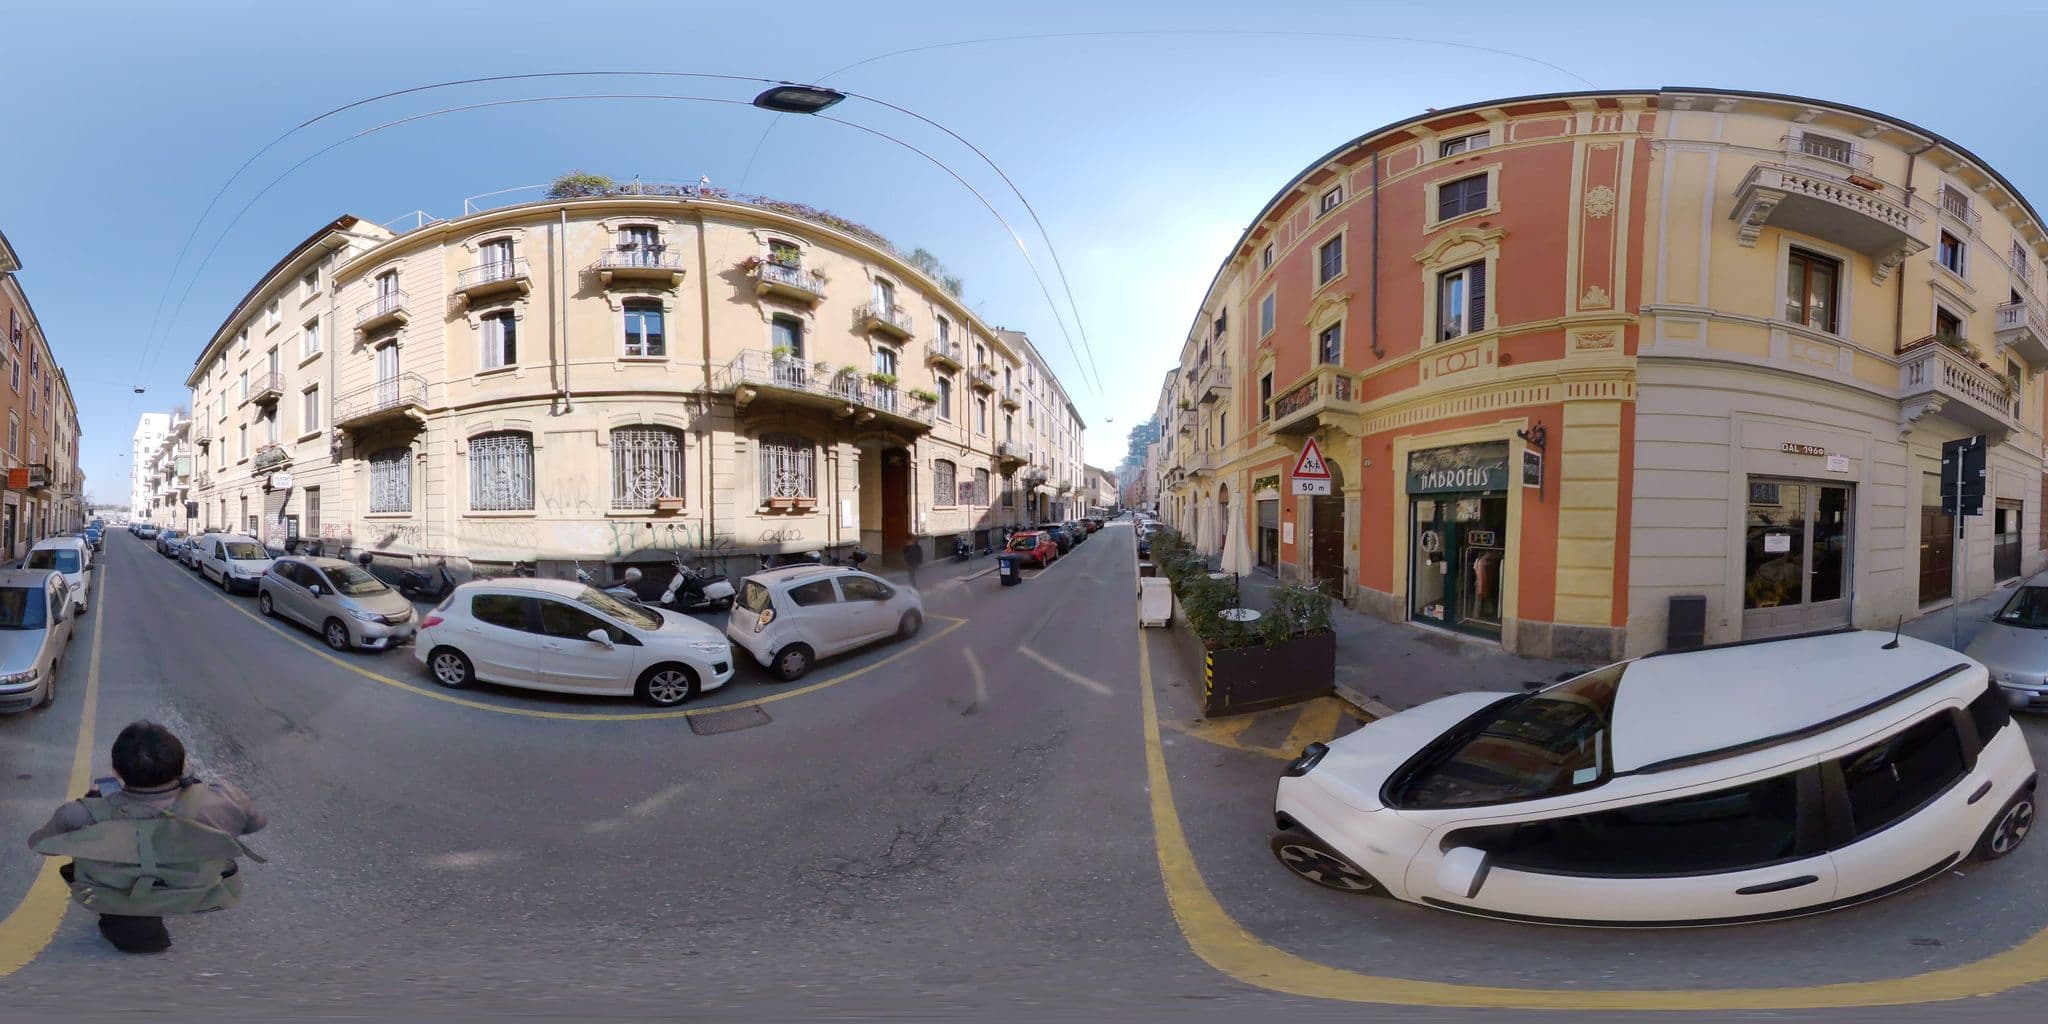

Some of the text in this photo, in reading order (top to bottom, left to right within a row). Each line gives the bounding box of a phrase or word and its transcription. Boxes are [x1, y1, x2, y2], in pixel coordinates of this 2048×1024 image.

[1782, 443, 1824, 455] DAL 1960
[1302, 482, 1314, 491] 50
